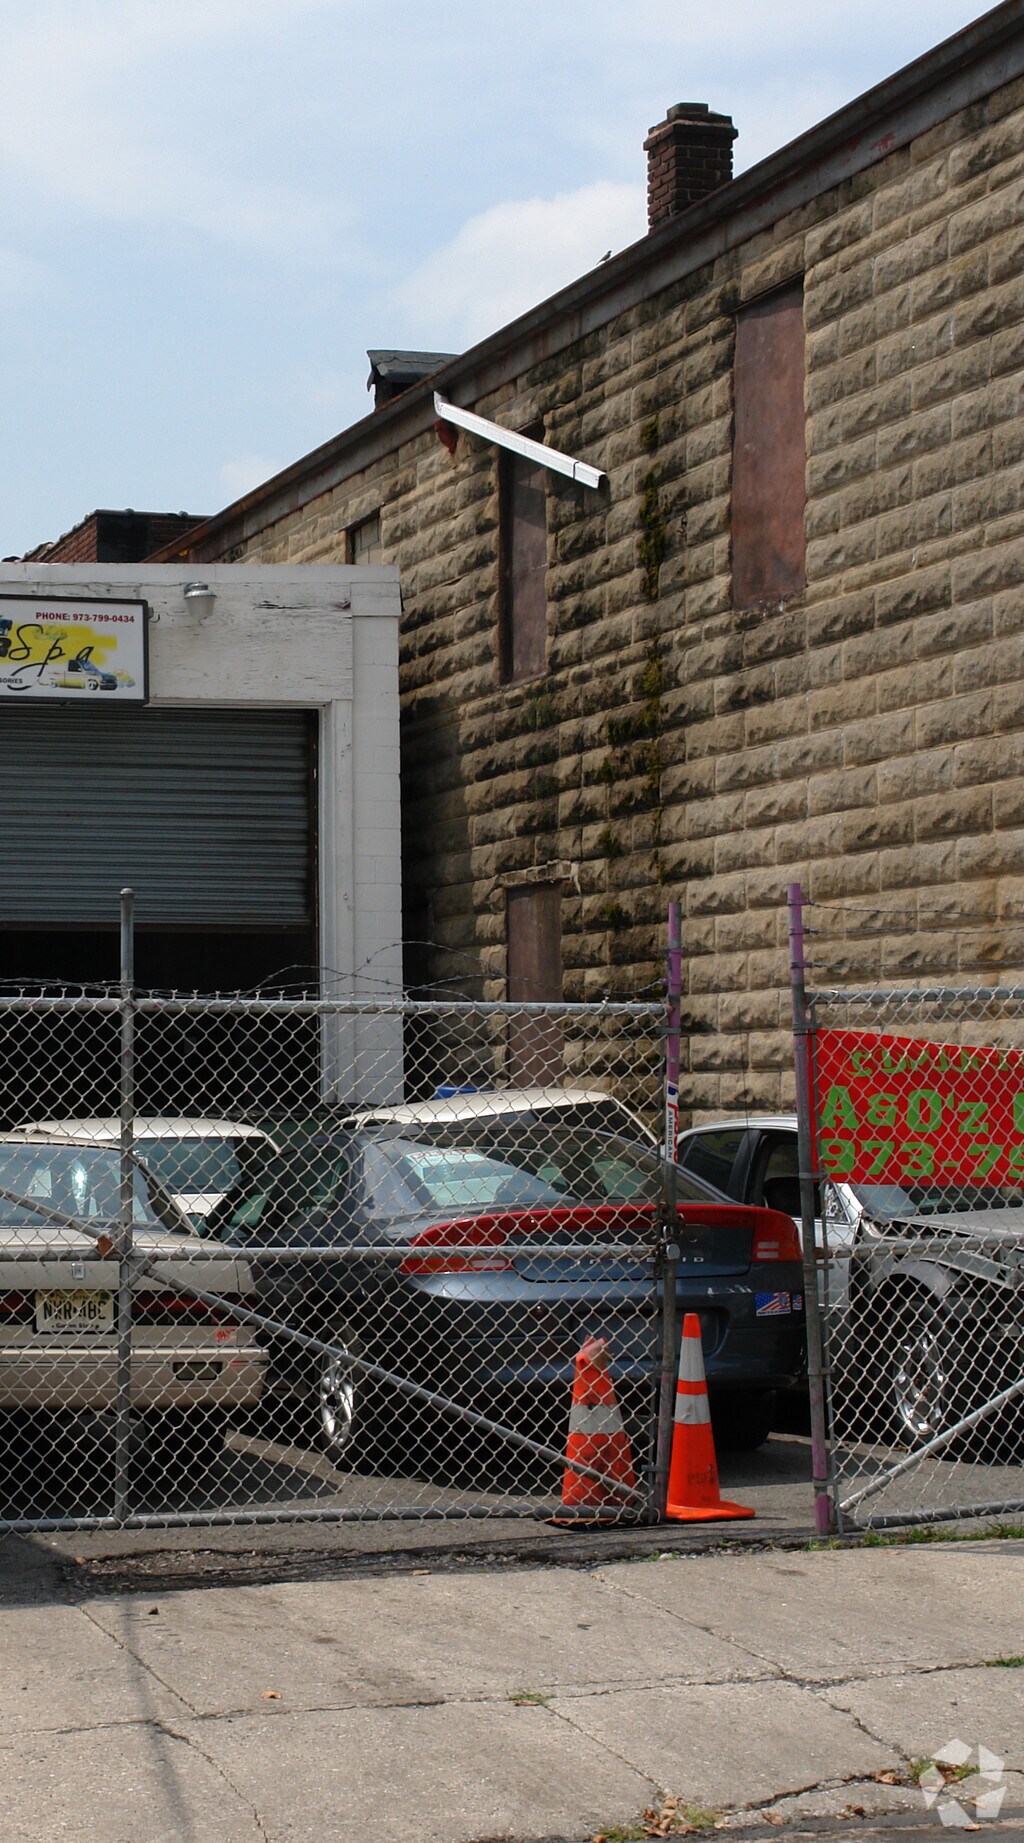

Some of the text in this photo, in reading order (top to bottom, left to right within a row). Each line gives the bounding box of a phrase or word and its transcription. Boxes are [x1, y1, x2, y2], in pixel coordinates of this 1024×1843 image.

[36, 612, 135, 623] PHONE: 973-799-0434
[8, 623, 94, 678] Spa
